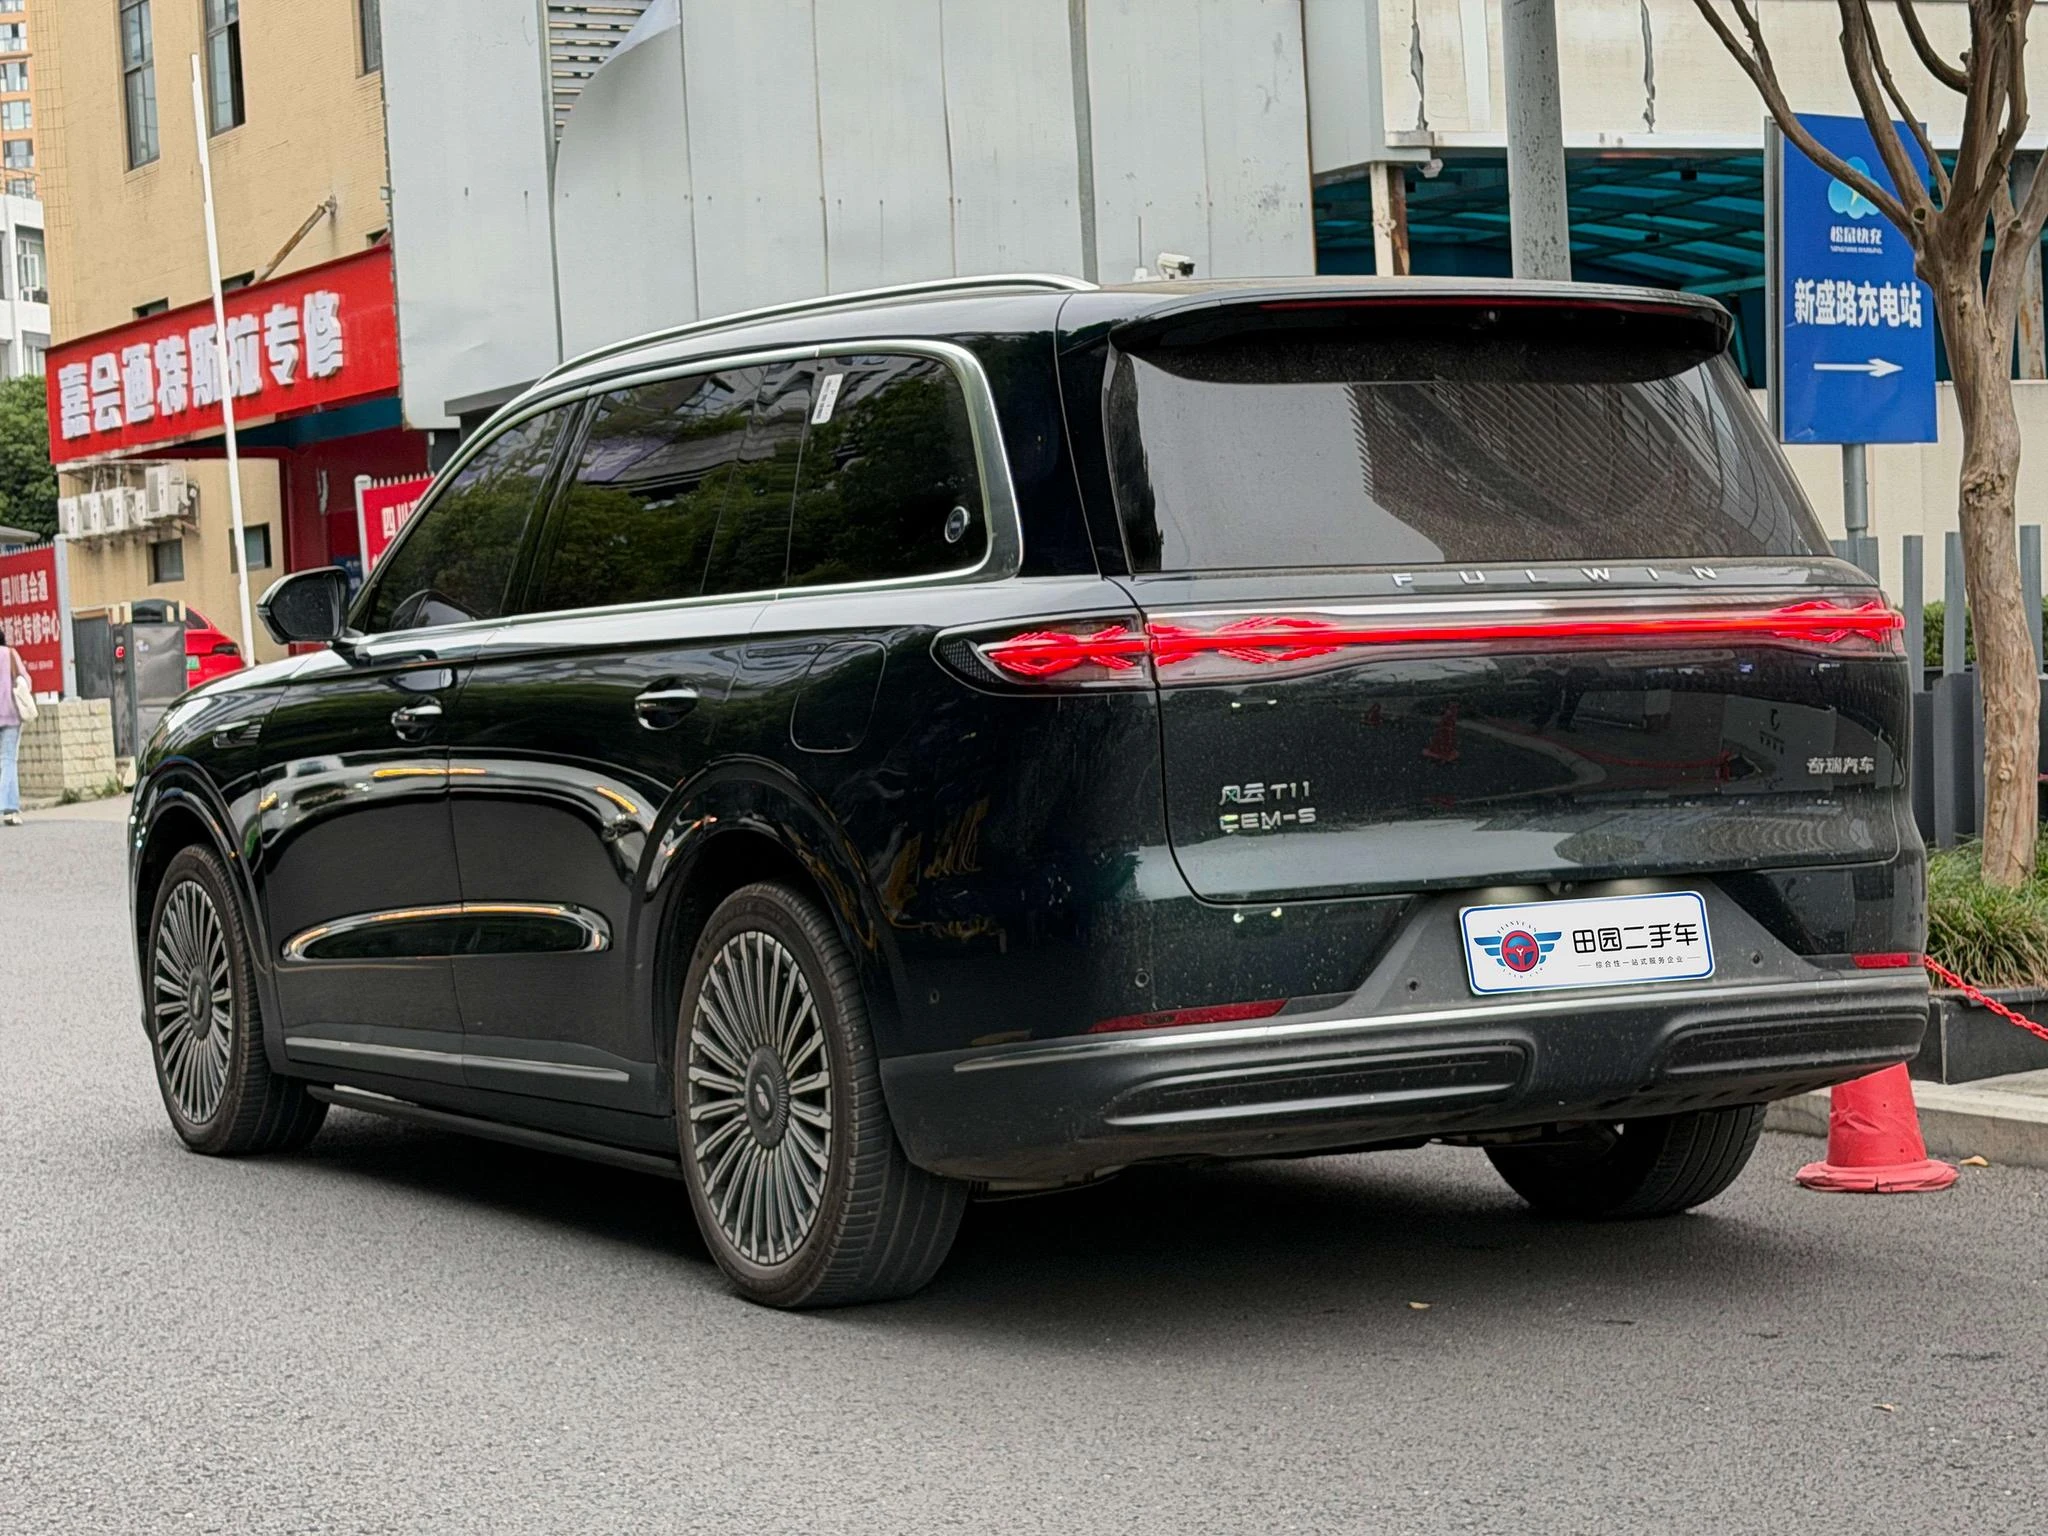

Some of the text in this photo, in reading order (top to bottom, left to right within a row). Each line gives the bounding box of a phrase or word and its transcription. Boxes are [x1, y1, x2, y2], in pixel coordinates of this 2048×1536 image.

[1794, 277, 1921, 328] 新盛路充电站
[1392, 566, 1717, 587] FULWIN
[1806, 756, 1875, 774] 奇瑞汽车
[1219, 807, 1316, 831] CEM-S
[1572, 922, 1699, 954] 田园二手车
[1595, 955, 1684, 969] 综合性一站式服务企业
